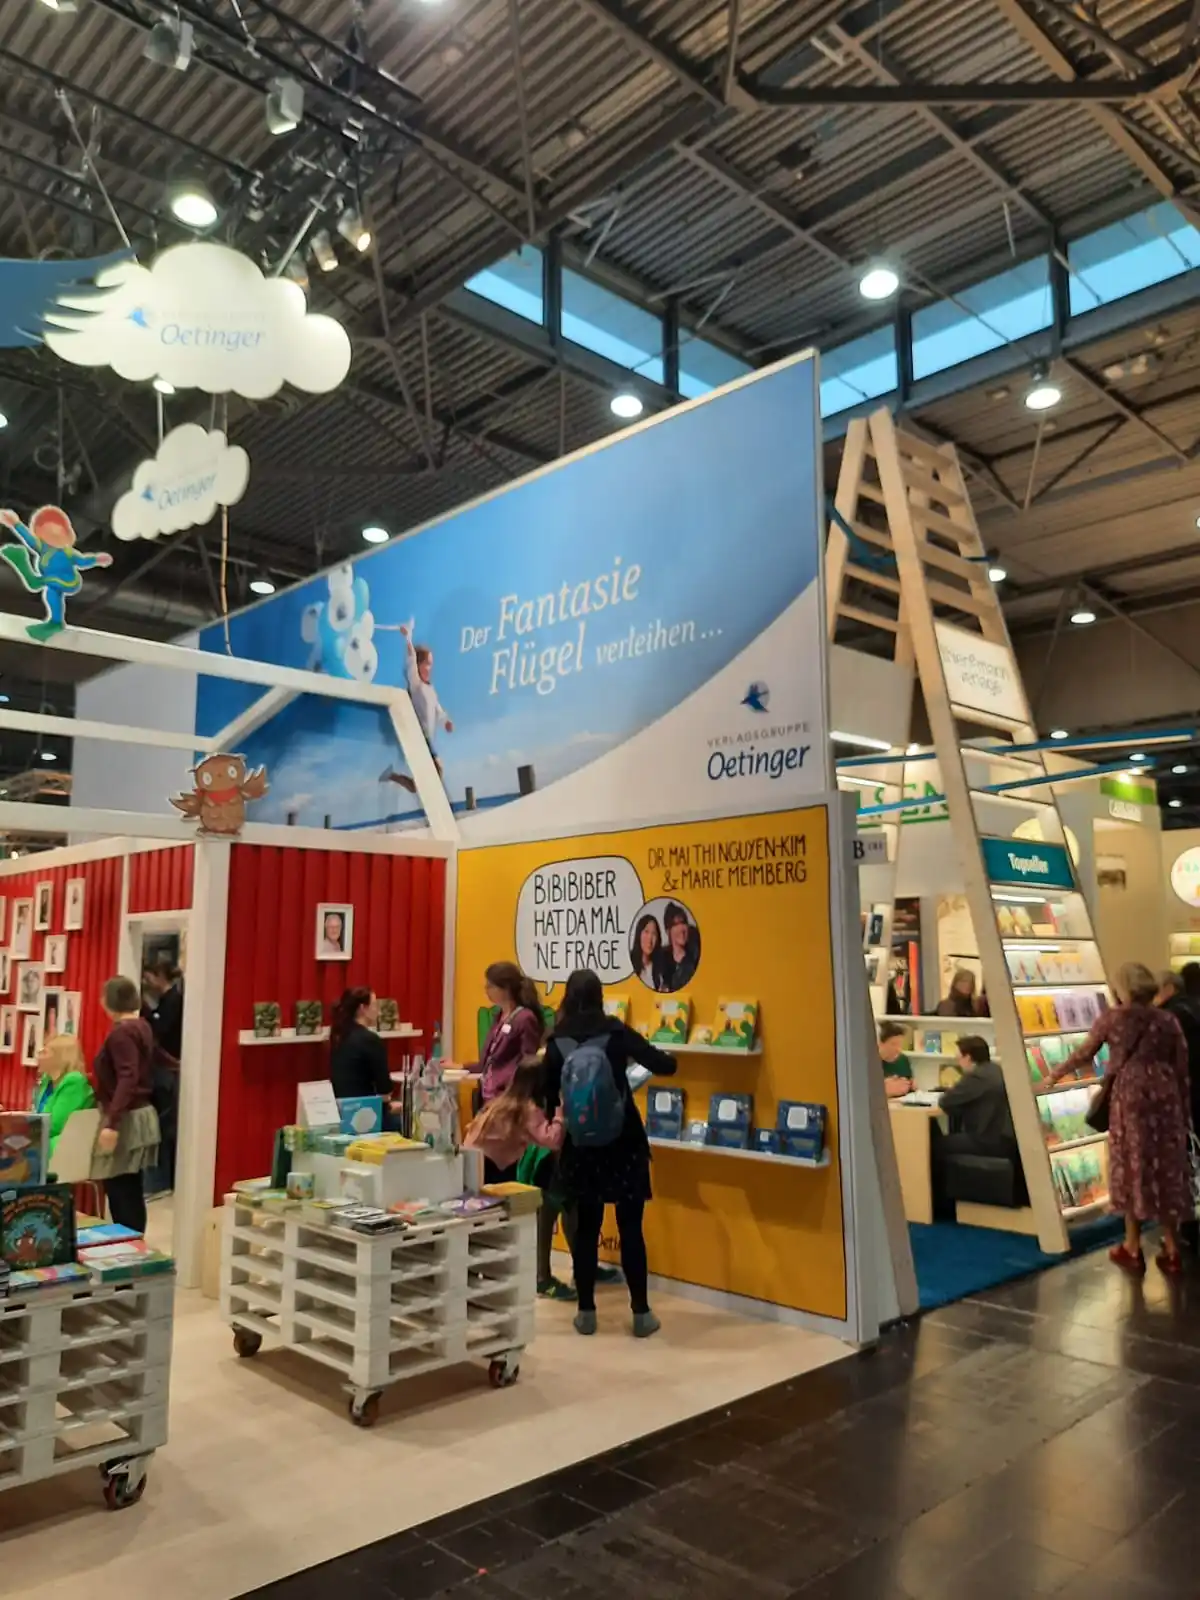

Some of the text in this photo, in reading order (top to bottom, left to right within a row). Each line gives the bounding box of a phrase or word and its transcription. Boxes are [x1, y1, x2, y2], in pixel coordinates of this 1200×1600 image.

[161, 323, 262, 351] Oetinger
[460, 555, 641, 653] Der Fantasie
[489, 620, 586, 696] Flügel
[707, 745, 811, 780] Oetinger
[669, 845, 690, 868] MAI
[692, 843, 716, 866] THI
[718, 834, 807, 863] NGUYEN-KIM
[534, 870, 617, 904] BIBIBIBER
[662, 859, 807, 892] & MARIE MEIMBERG
[534, 905, 625, 937] HAT DA MAL
[565, 940, 621, 970] FRAGE
